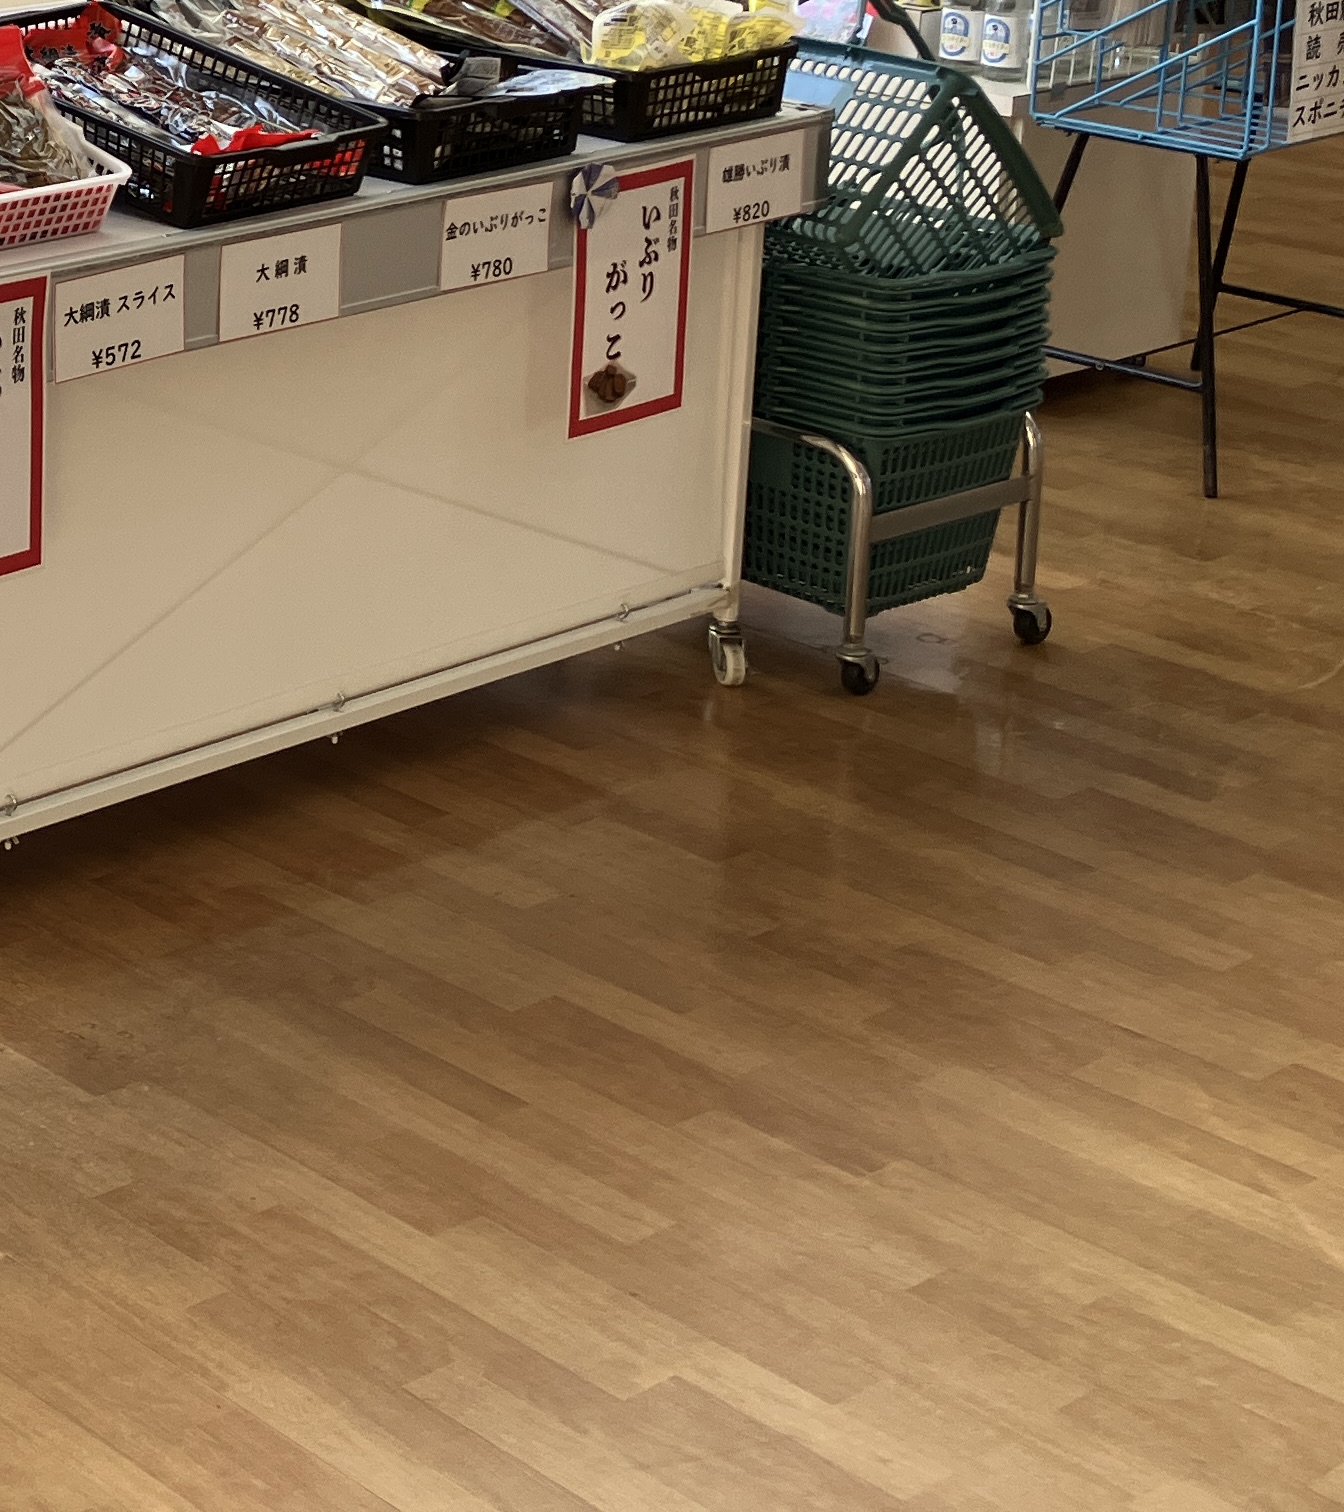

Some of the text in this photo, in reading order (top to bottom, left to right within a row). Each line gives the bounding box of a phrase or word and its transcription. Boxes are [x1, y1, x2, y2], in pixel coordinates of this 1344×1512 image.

[1295, 64, 1344, 92] ニッカ
[444, 206, 548, 242] 金のいぶりがっこ
[666, 185, 680, 252] 秋田名物
[733, 200, 771, 224] ¥820
[255, 254, 309, 284] 大綱漬
[470, 256, 514, 282] ¥780
[637, 203, 663, 304] いぶり
[62, 282, 178, 329] 大綱漬 スライス
[252, 301, 301, 330] ¥778
[604, 259, 630, 361] がっこ
[11, 306, 26, 385] 秋田名物
[90, 337, 143, 368] ¥572
